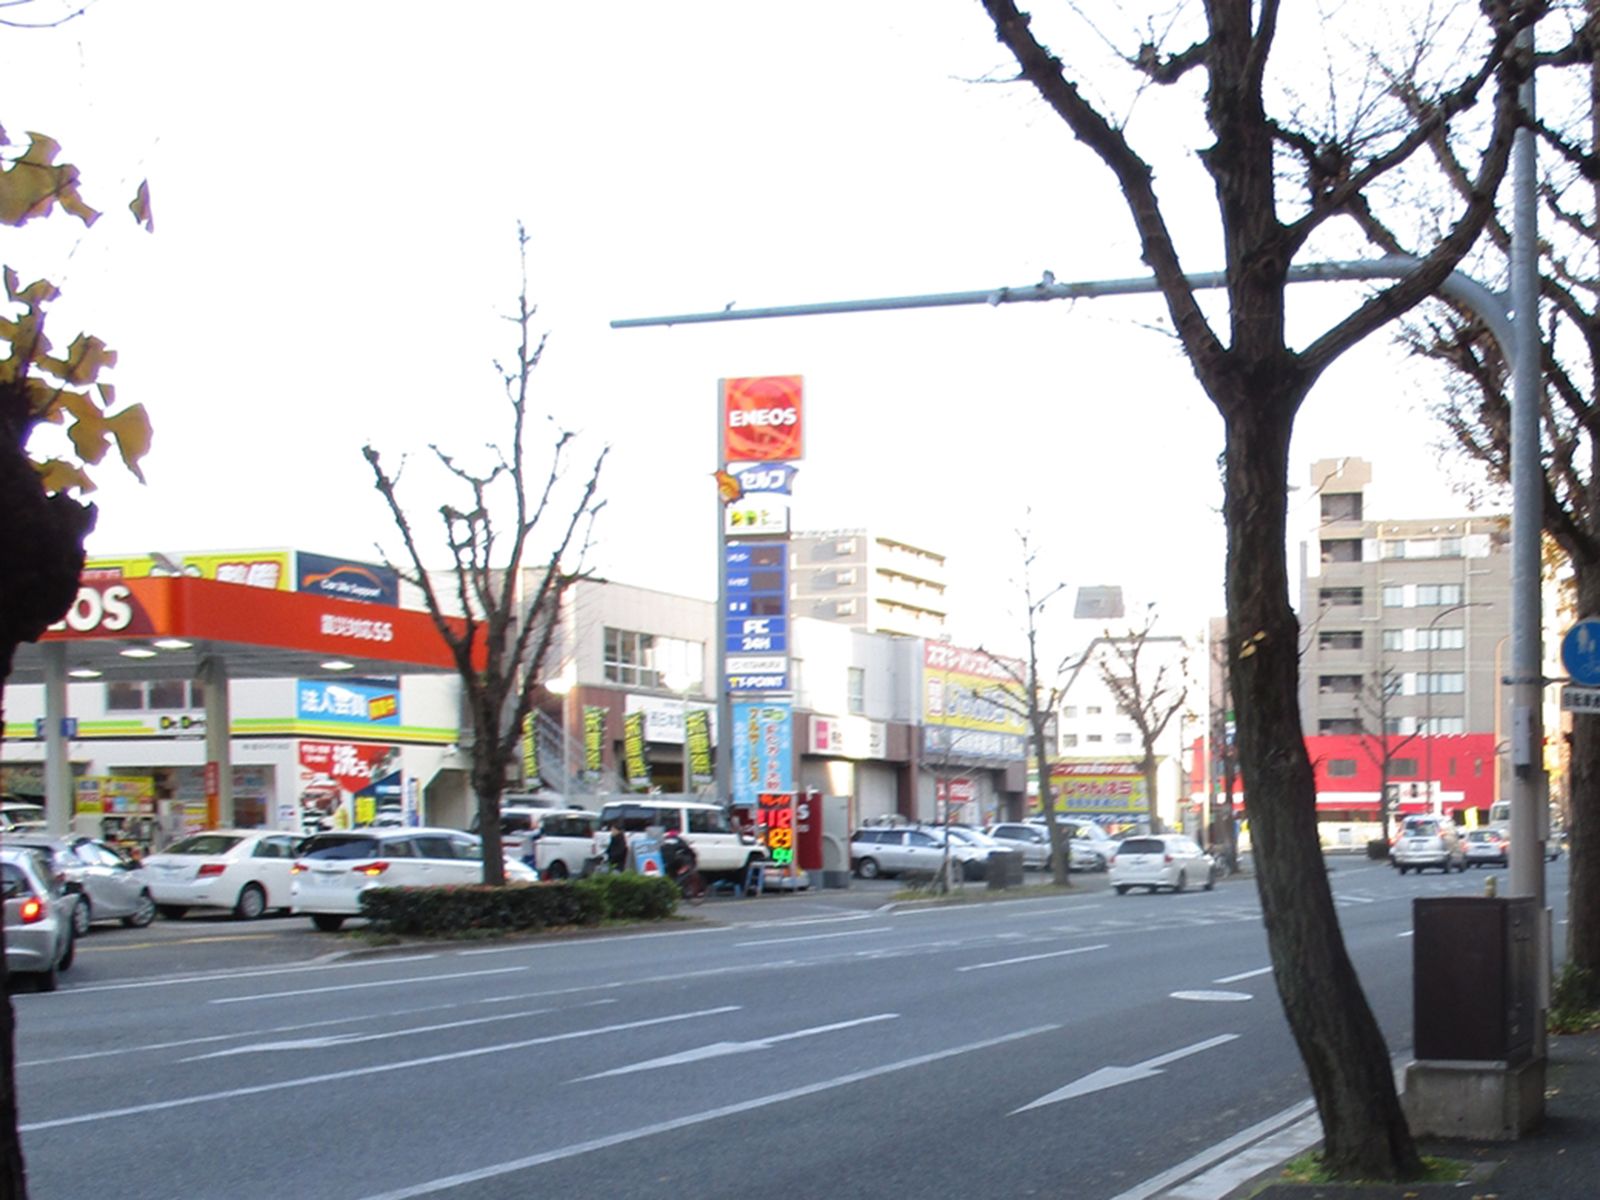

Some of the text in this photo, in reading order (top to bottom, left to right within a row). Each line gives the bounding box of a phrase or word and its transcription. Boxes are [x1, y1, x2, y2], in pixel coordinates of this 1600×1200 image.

[729, 407, 797, 428] ENEOS
[739, 469, 787, 490] セルフ
